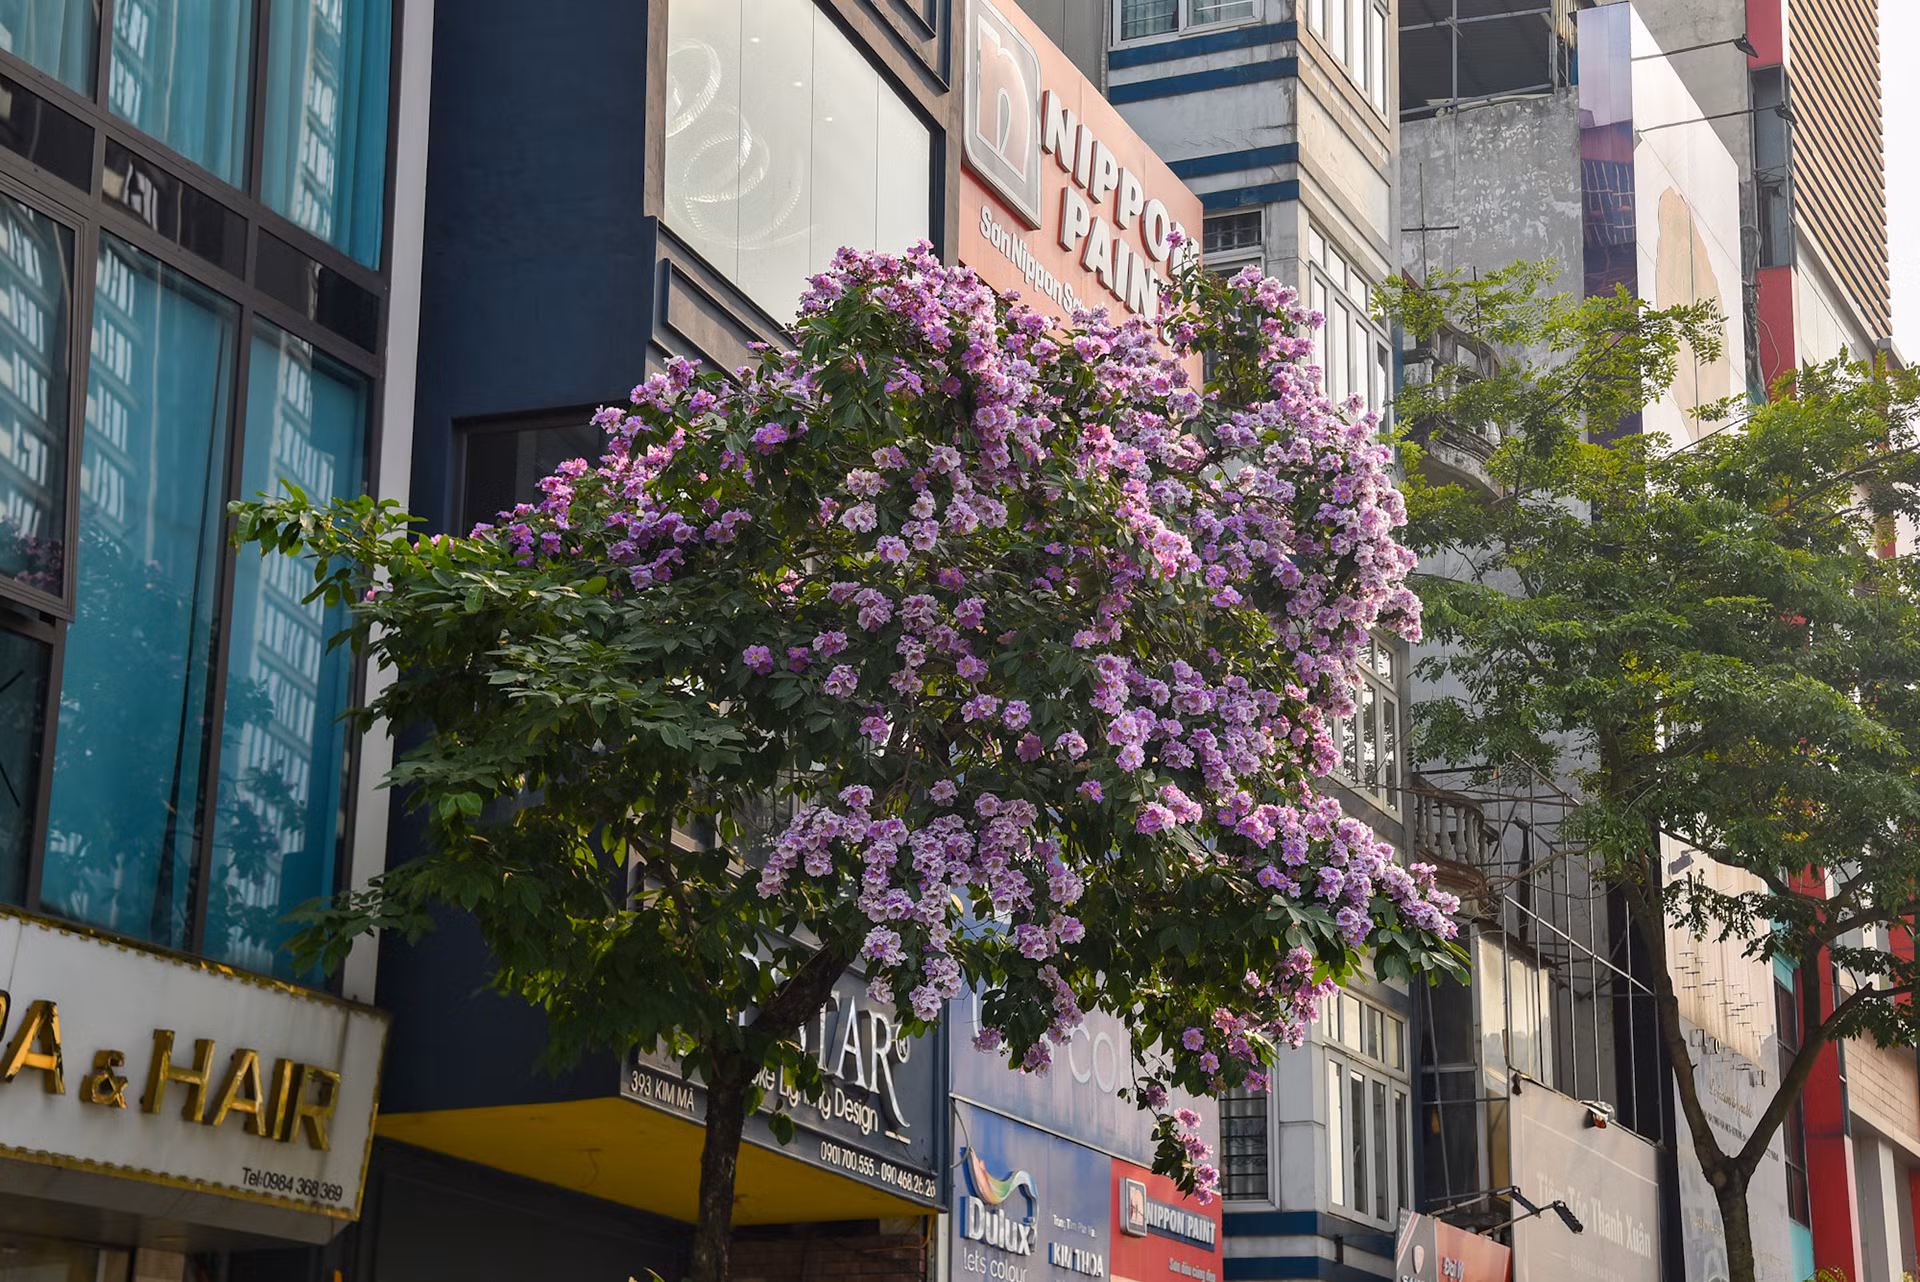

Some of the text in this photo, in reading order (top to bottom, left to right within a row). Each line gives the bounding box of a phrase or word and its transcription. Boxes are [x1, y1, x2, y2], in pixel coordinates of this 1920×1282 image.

[1058, 185, 1172, 345] PAIN
[0, 989, 340, 1151] A & HAIR
[631, 1070, 651, 1096] 393
[655, 1079, 675, 1105] KIM
[834, 1087, 878, 1135] Design
[296, 1178, 319, 1198] 368
[320, 1182, 343, 1201] 369
[961, 1195, 1031, 1256] Dulux
[1146, 1201, 1216, 1245] NIPPON PAINT
[1590, 1196, 1624, 1247] Thanh
[1626, 1214, 1651, 1260] Xuân
[1053, 1242, 1104, 1278] KIM THOA
